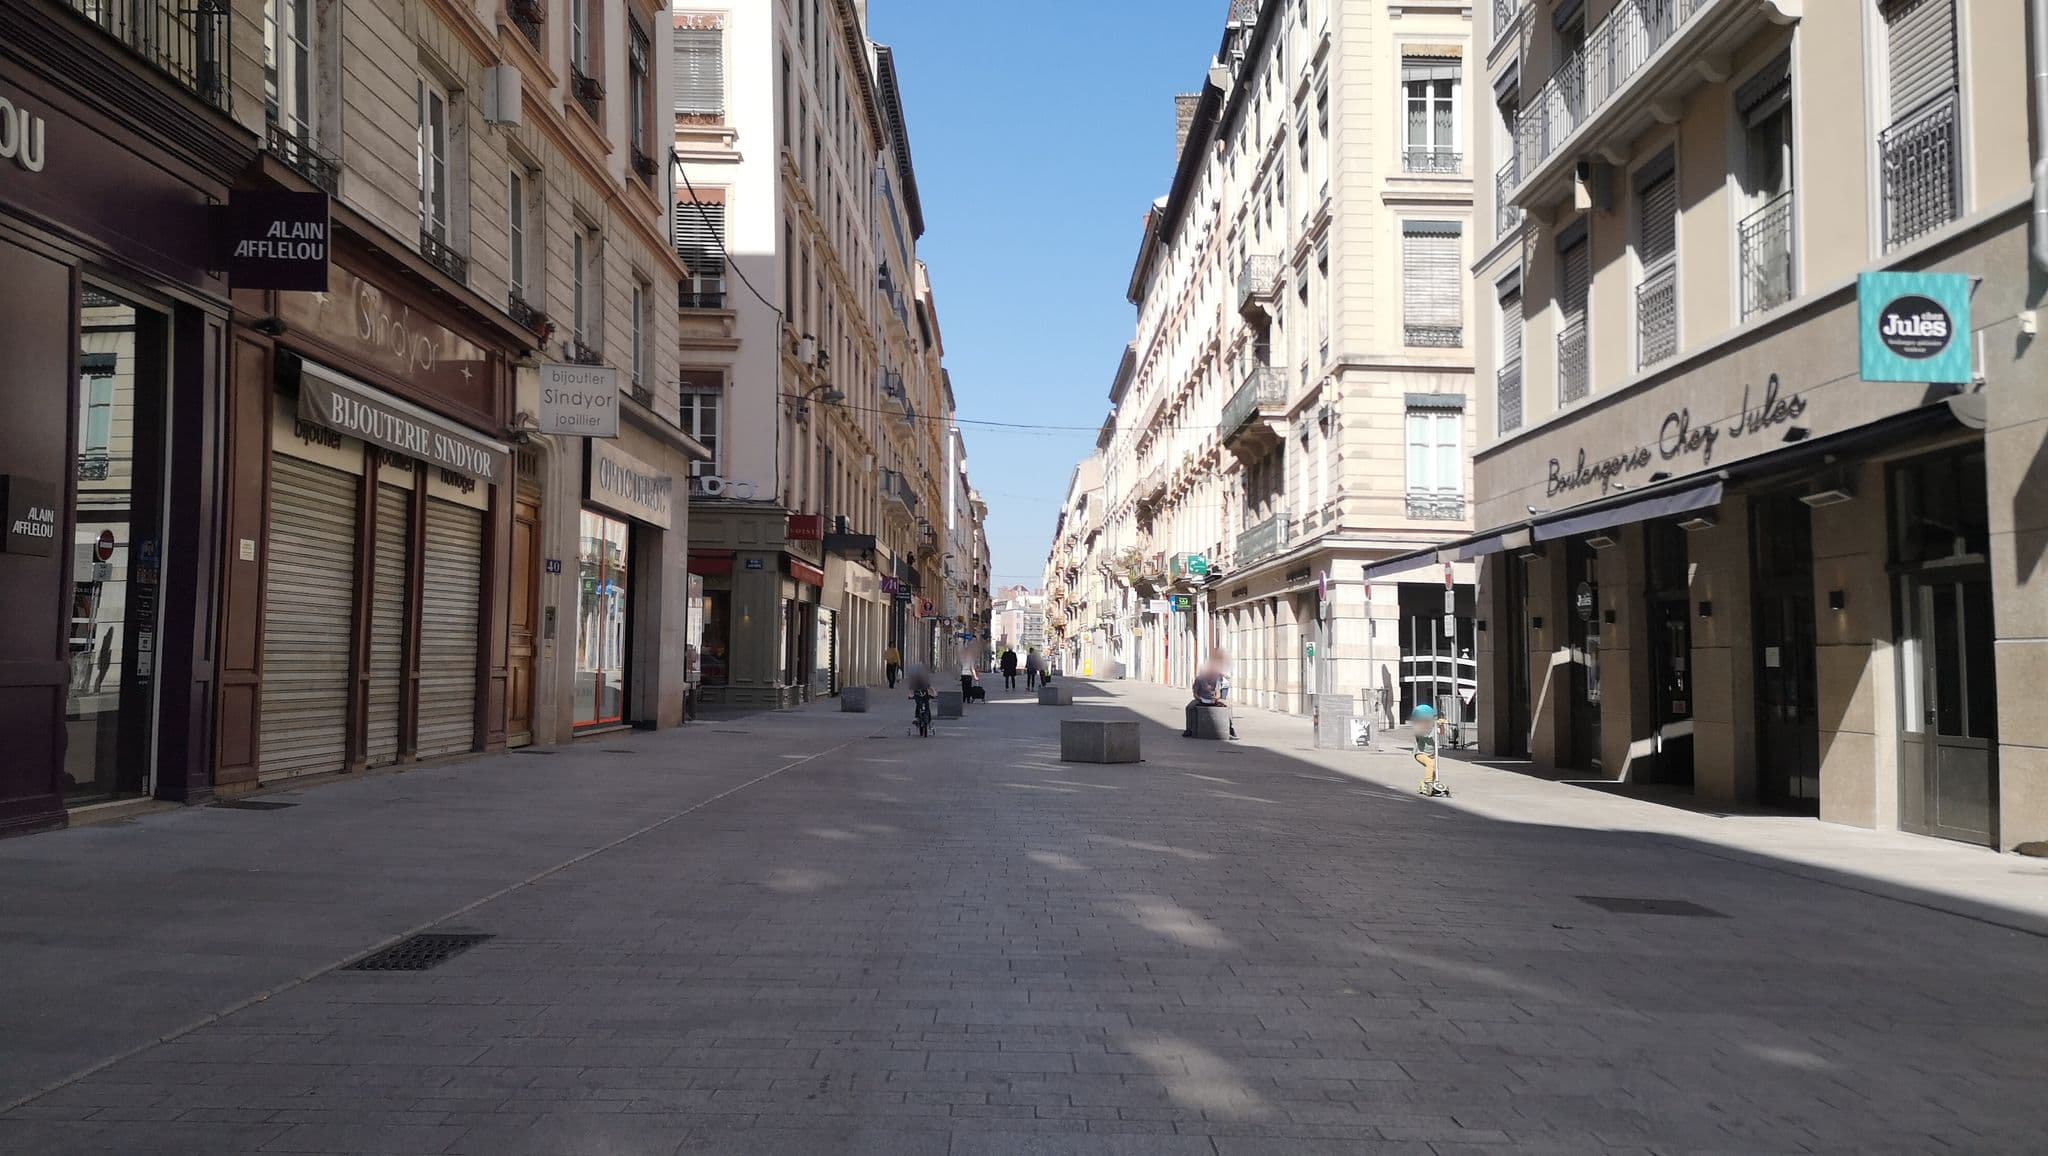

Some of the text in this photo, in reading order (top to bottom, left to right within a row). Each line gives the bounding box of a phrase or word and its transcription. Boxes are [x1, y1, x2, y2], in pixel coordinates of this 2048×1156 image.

[267, 220, 324, 240] ALAIN
[233, 239, 324, 260] AFFLELOU
[360, 288, 439, 374] Sindyor
[1883, 314, 1947, 337] Jules
[552, 370, 605, 385] bijoutier
[544, 388, 613, 409] Sindyor
[555, 412, 601, 427] joaillier
[331, 392, 492, 478] BIJOUTERIE SINDYOR
[1546, 373, 1807, 498] Boulangerie Chez Jules
[28, 507, 54, 523] ALAIN
[12, 520, 54, 538] AFFLELOU
[547, 561, 560, 572] 40
